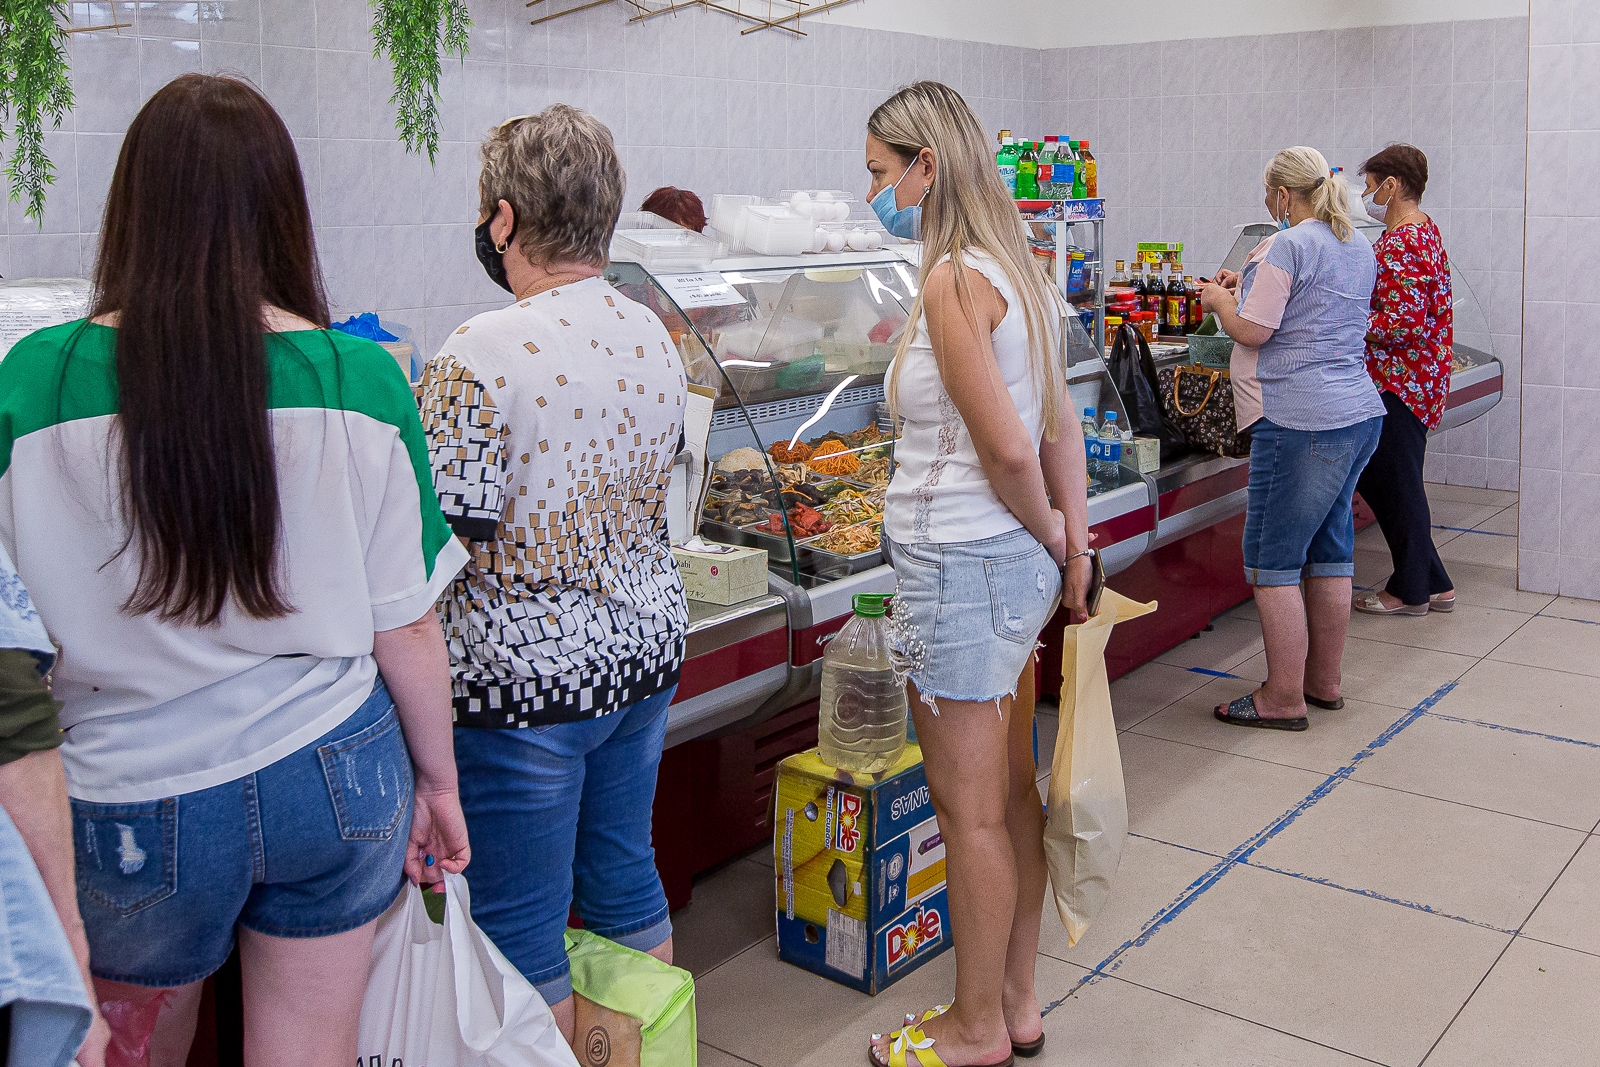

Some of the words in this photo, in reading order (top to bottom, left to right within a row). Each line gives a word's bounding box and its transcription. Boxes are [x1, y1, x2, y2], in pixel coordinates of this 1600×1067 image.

[826, 786, 835, 810] From
[840, 792, 861, 852] Dole
[824, 811, 833, 850] Ecuador
[887, 908, 941, 966] Dole
